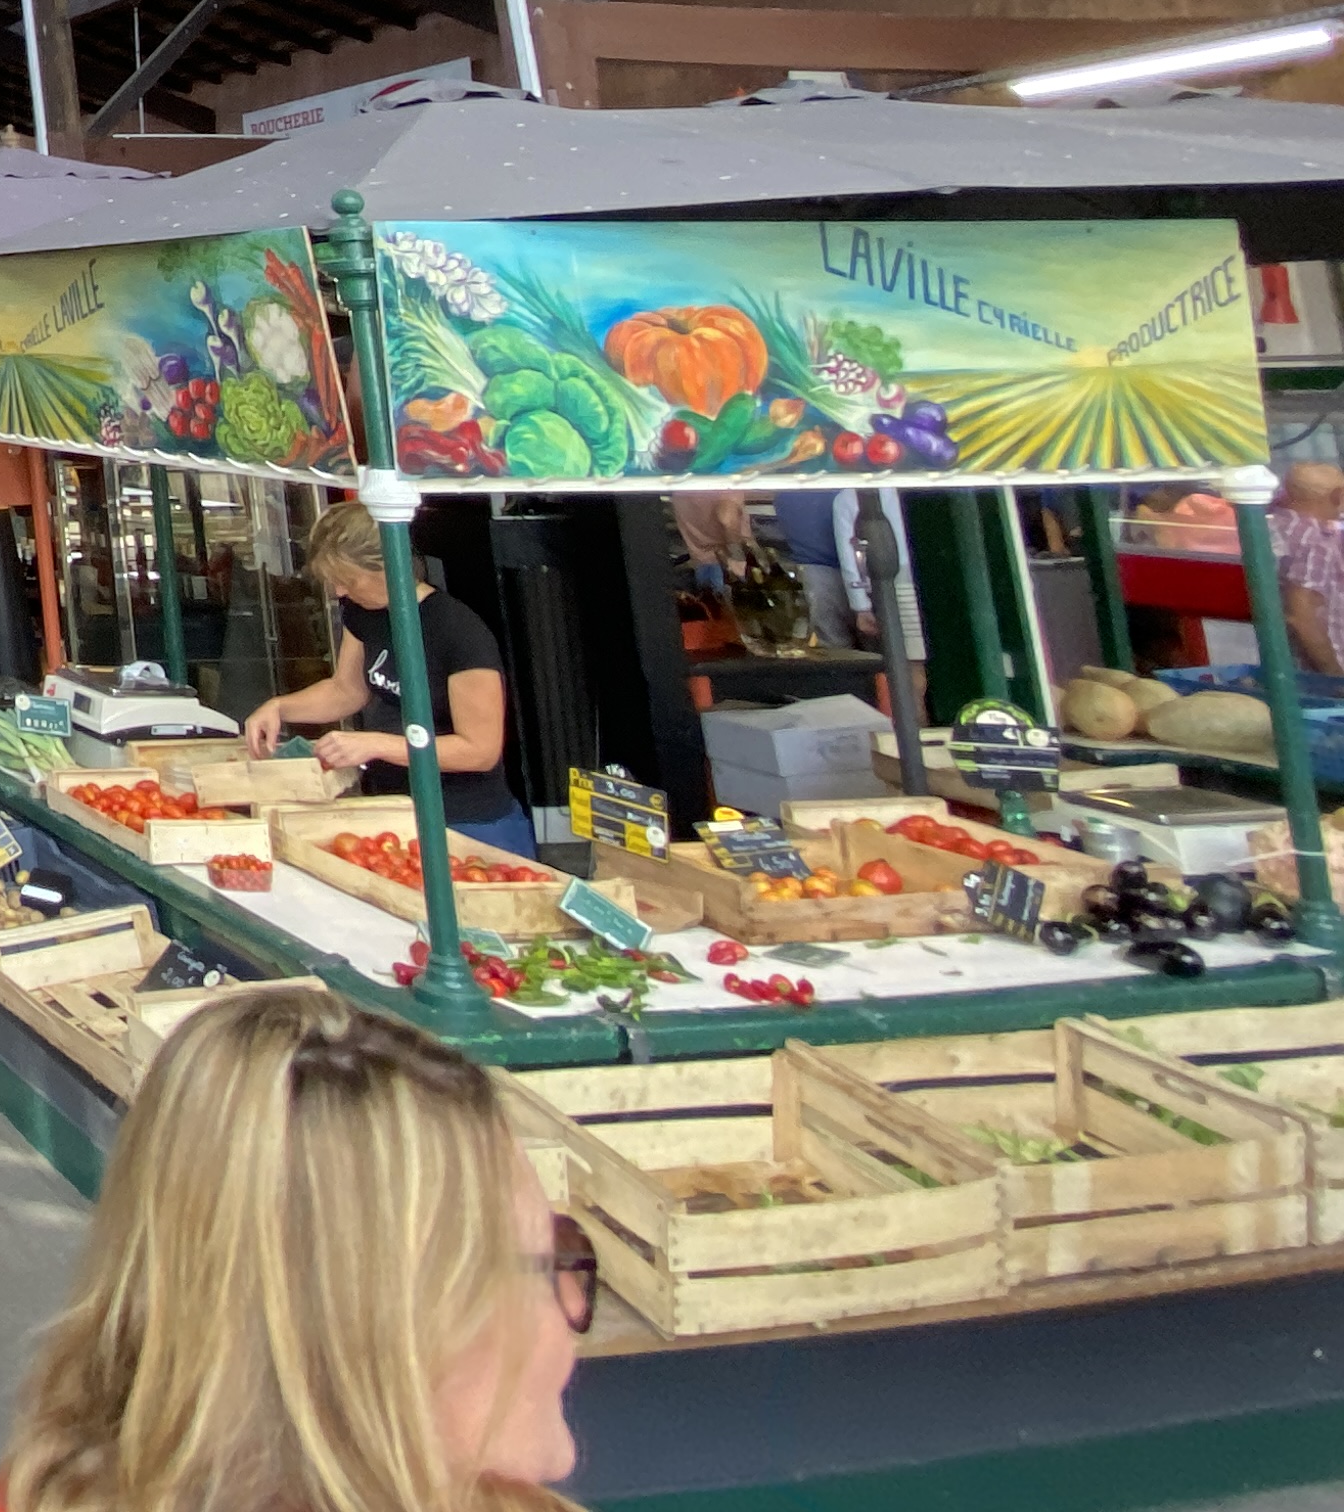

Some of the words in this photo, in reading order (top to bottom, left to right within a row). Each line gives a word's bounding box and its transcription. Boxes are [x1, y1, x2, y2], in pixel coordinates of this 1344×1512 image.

[250, 107, 325, 135] BOUCHERIE
[52, 258, 105, 333] LAVILLE
[1106, 254, 1242, 367] PRODUCTRICE
